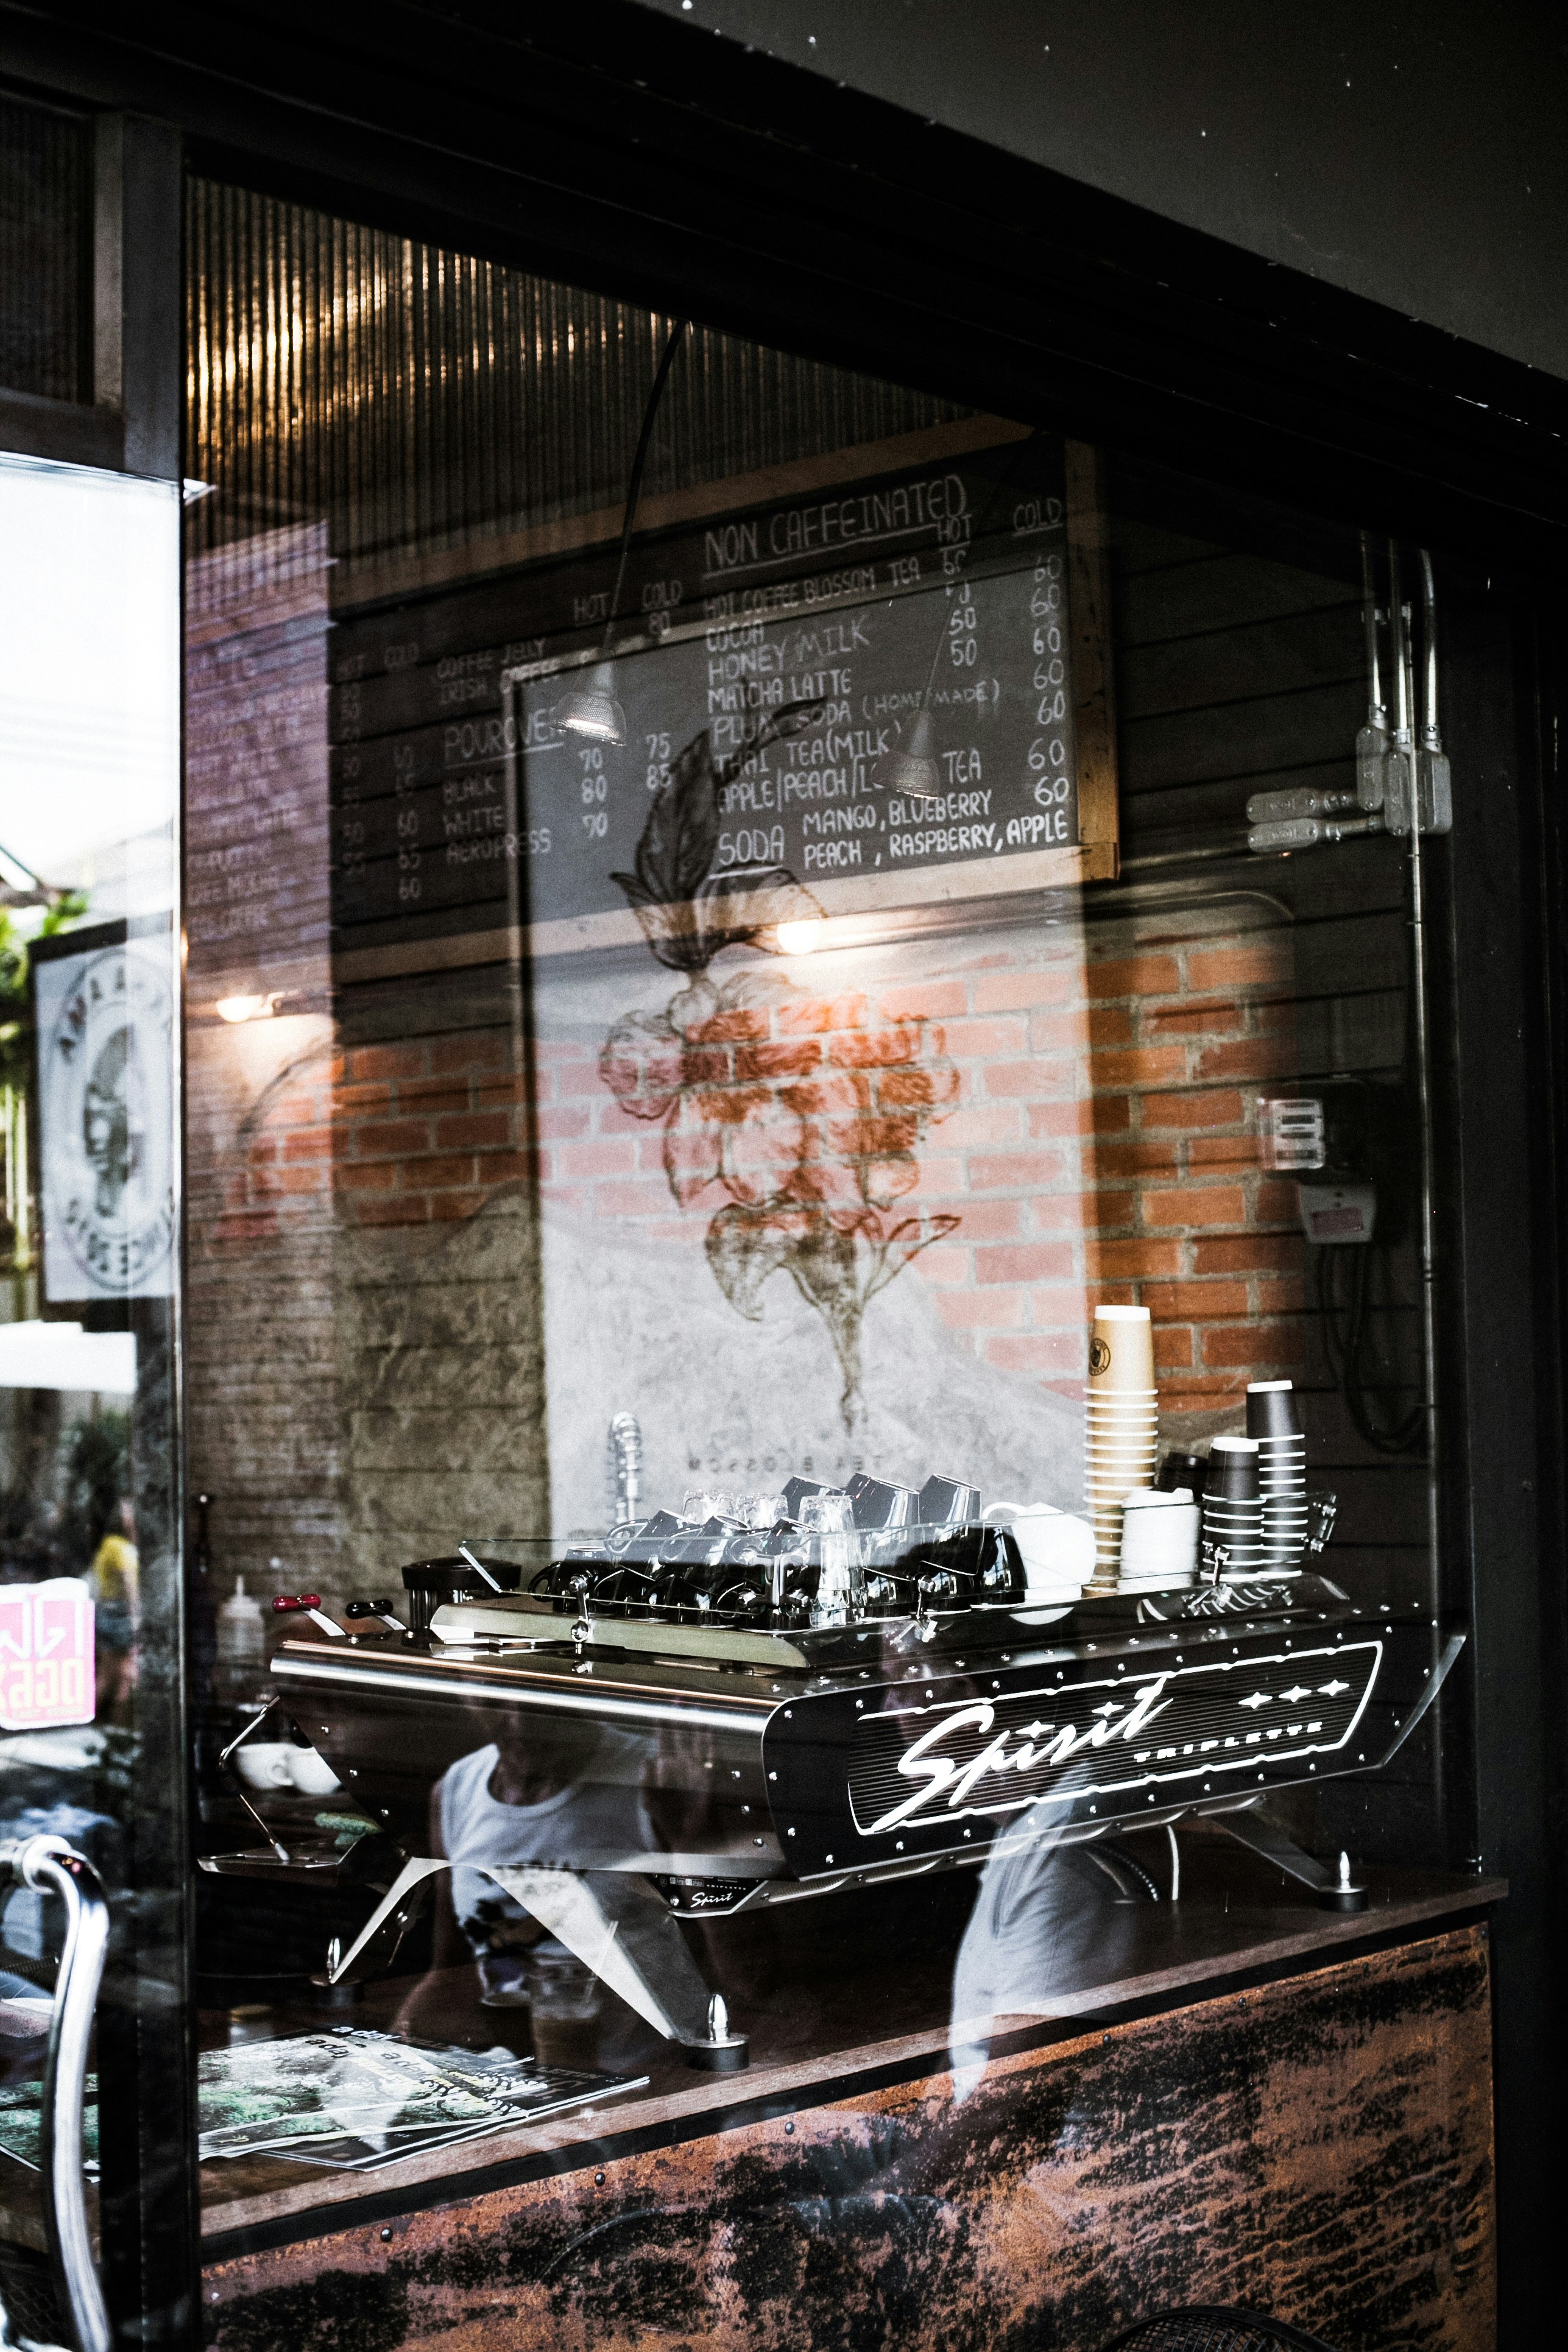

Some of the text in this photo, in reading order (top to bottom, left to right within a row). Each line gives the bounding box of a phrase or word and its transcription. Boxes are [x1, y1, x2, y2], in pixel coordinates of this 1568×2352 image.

[705, 474, 968, 574] NON CAFFEINATED
[937, 498, 1062, 543] HOT COLD
[573, 579, 683, 623] HOT COLD
[803, 567, 877, 604] BLOSSOM
[887, 556, 921, 588] TEA
[708, 584, 1061, 687] HONEY MILK 50 60
[707, 626, 1062, 713] MATCHA LATTE 50 60
[1032, 657, 1065, 691] 60
[1037, 689, 1067, 726] 60
[576, 746, 604, 773] 70
[645, 730, 673, 761] 75
[942, 746, 983, 785] TEA
[1027, 736, 1066, 771] 60
[581, 774, 609, 805] 80
[645, 761, 674, 793] 85
[581, 810, 609, 841] 70
[719, 824, 786, 867] SODA
[888, 788, 994, 827] BLUEBERRY
[1034, 774, 1071, 808] 60
[1006, 807, 1070, 847] APPLE
[869, 1675, 1174, 1832] Spirit
[1134, 1721, 1326, 1763] TRIPLETTE
[690, 1891, 734, 1908] Spirit
